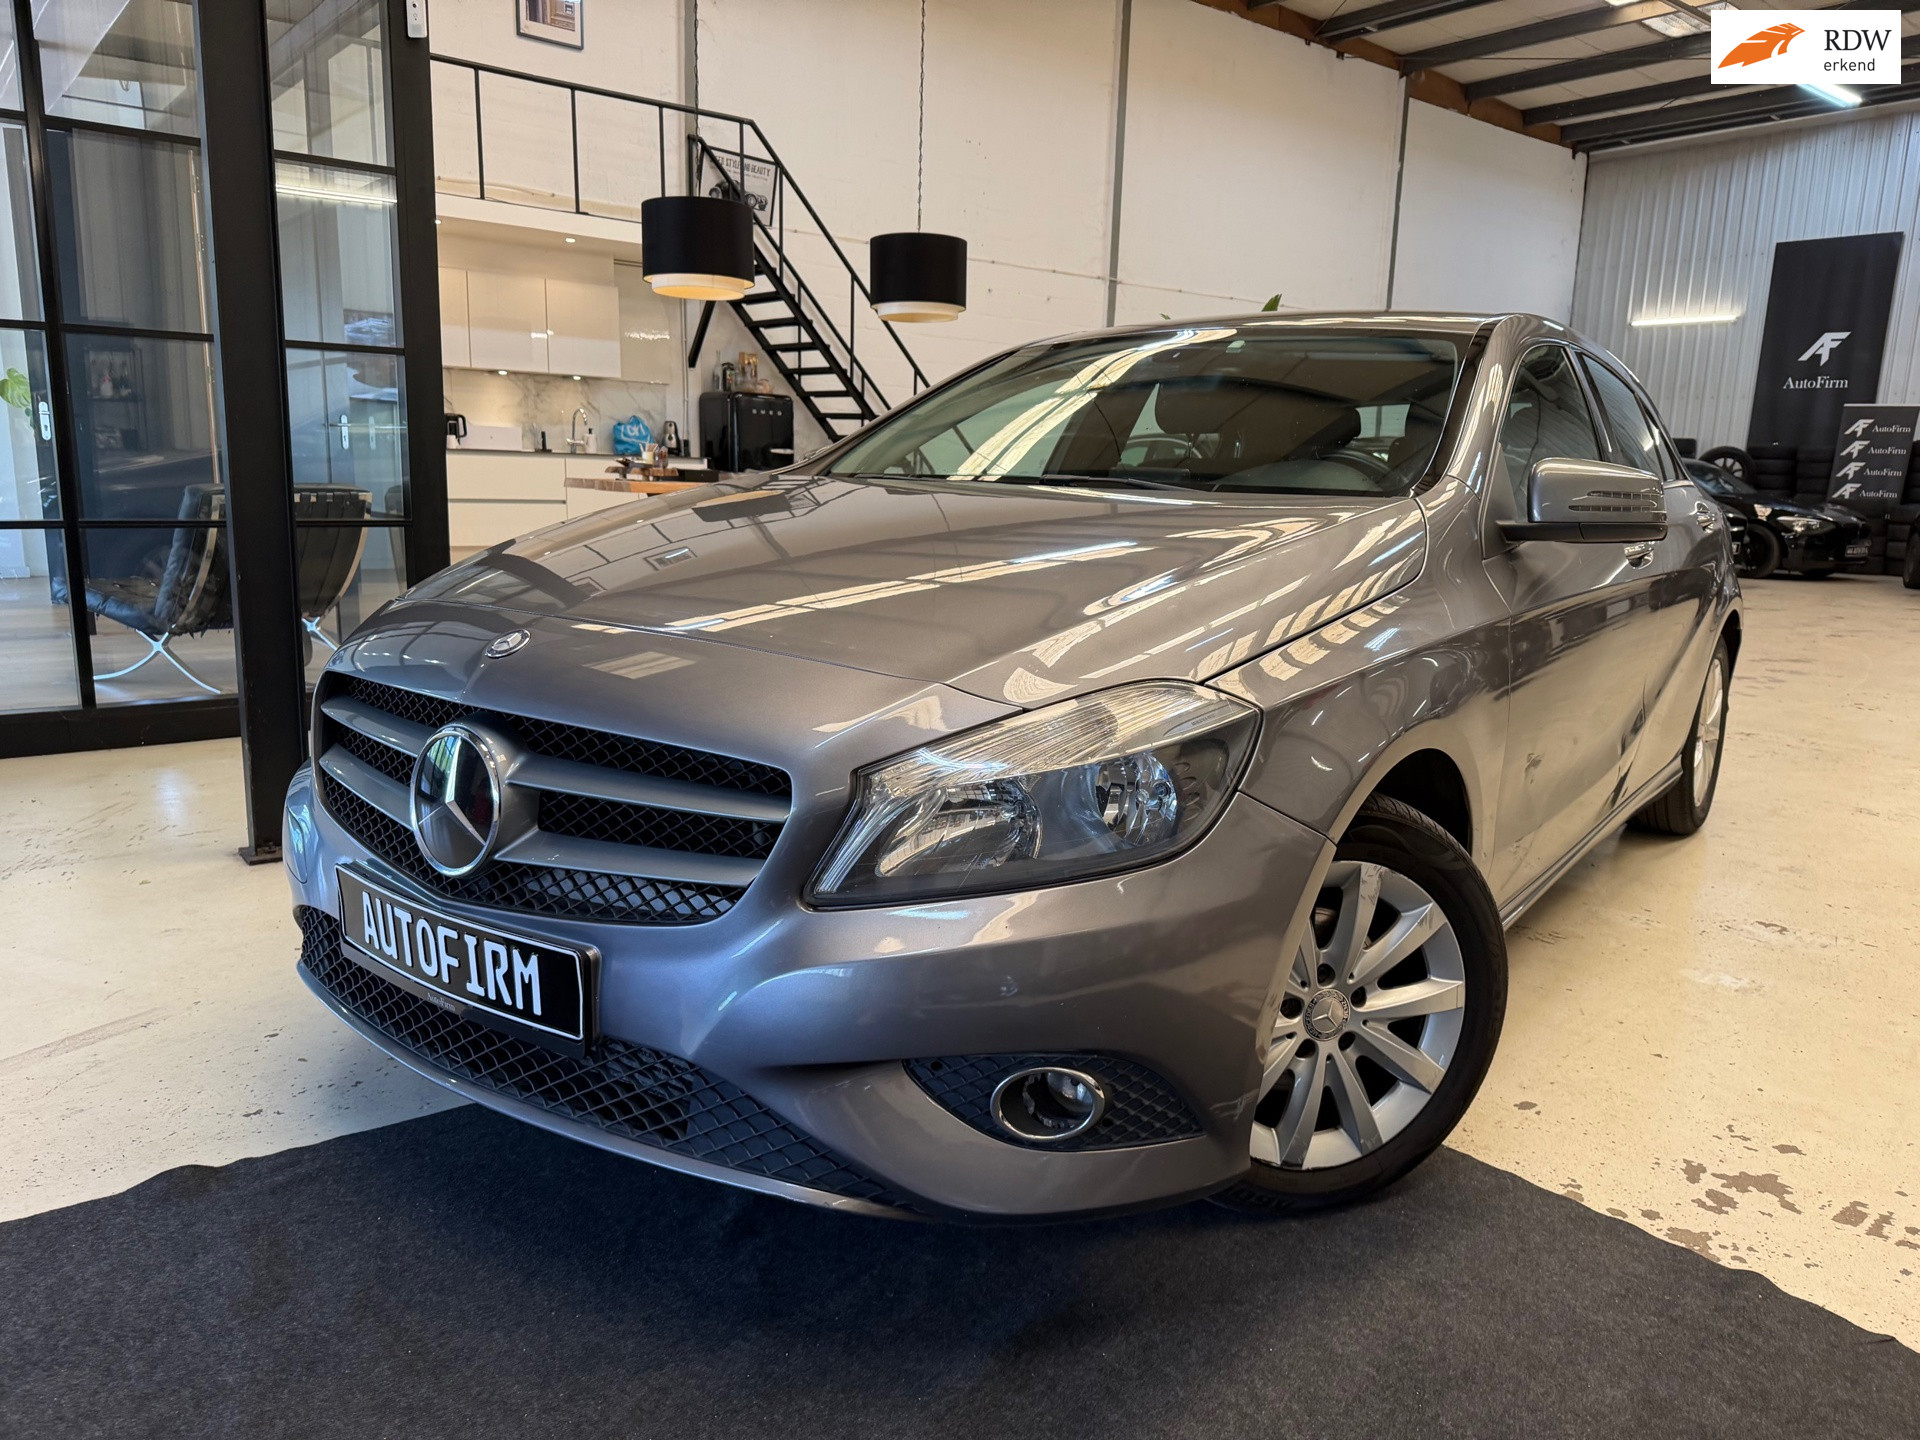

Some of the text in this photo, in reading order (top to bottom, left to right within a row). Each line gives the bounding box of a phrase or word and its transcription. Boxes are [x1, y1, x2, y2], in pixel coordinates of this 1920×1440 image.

[1782, 375, 1848, 389] AutoFirm
[1872, 425, 1911, 433] AutoFirm
[1867, 446, 1906, 455] AutoFirm
[1863, 467, 1902, 477] AutoFirm
[1859, 489, 1898, 499] AutoFirm
[362, 890, 542, 1016] AUTOFIRM
